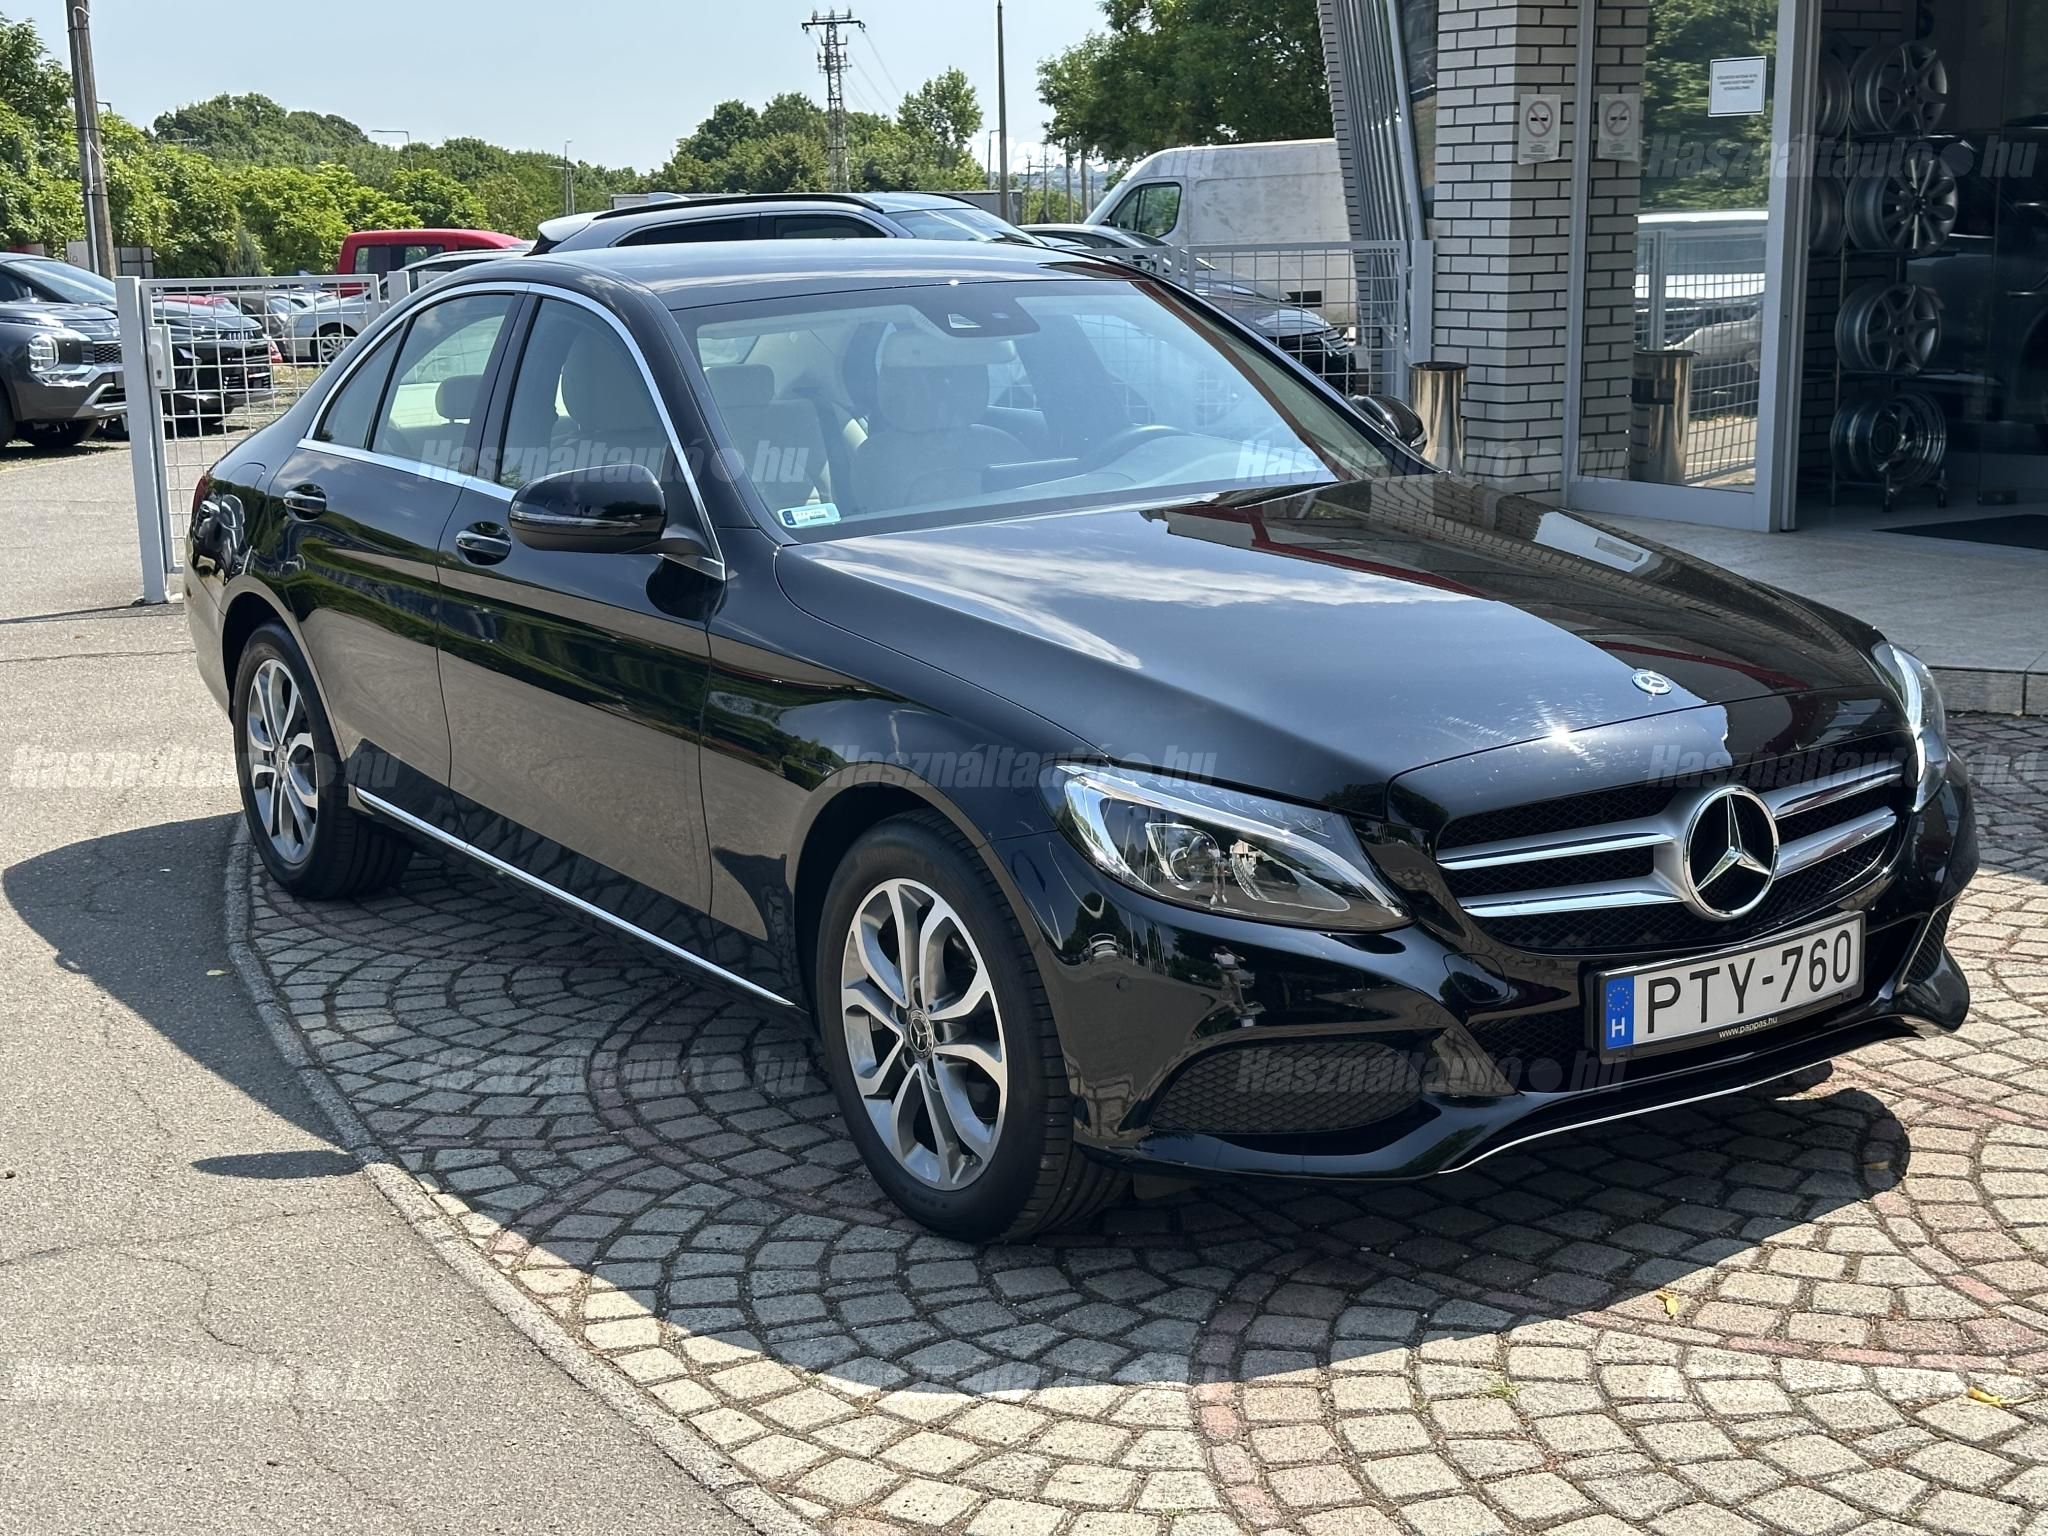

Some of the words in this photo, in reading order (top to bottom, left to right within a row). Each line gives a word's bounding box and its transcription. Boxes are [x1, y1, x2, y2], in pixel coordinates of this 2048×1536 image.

[1647, 929, 1851, 1034] PTY-760
[1610, 1016, 1626, 1039] H
[1718, 1016, 1779, 1039] www.pappas.hu
